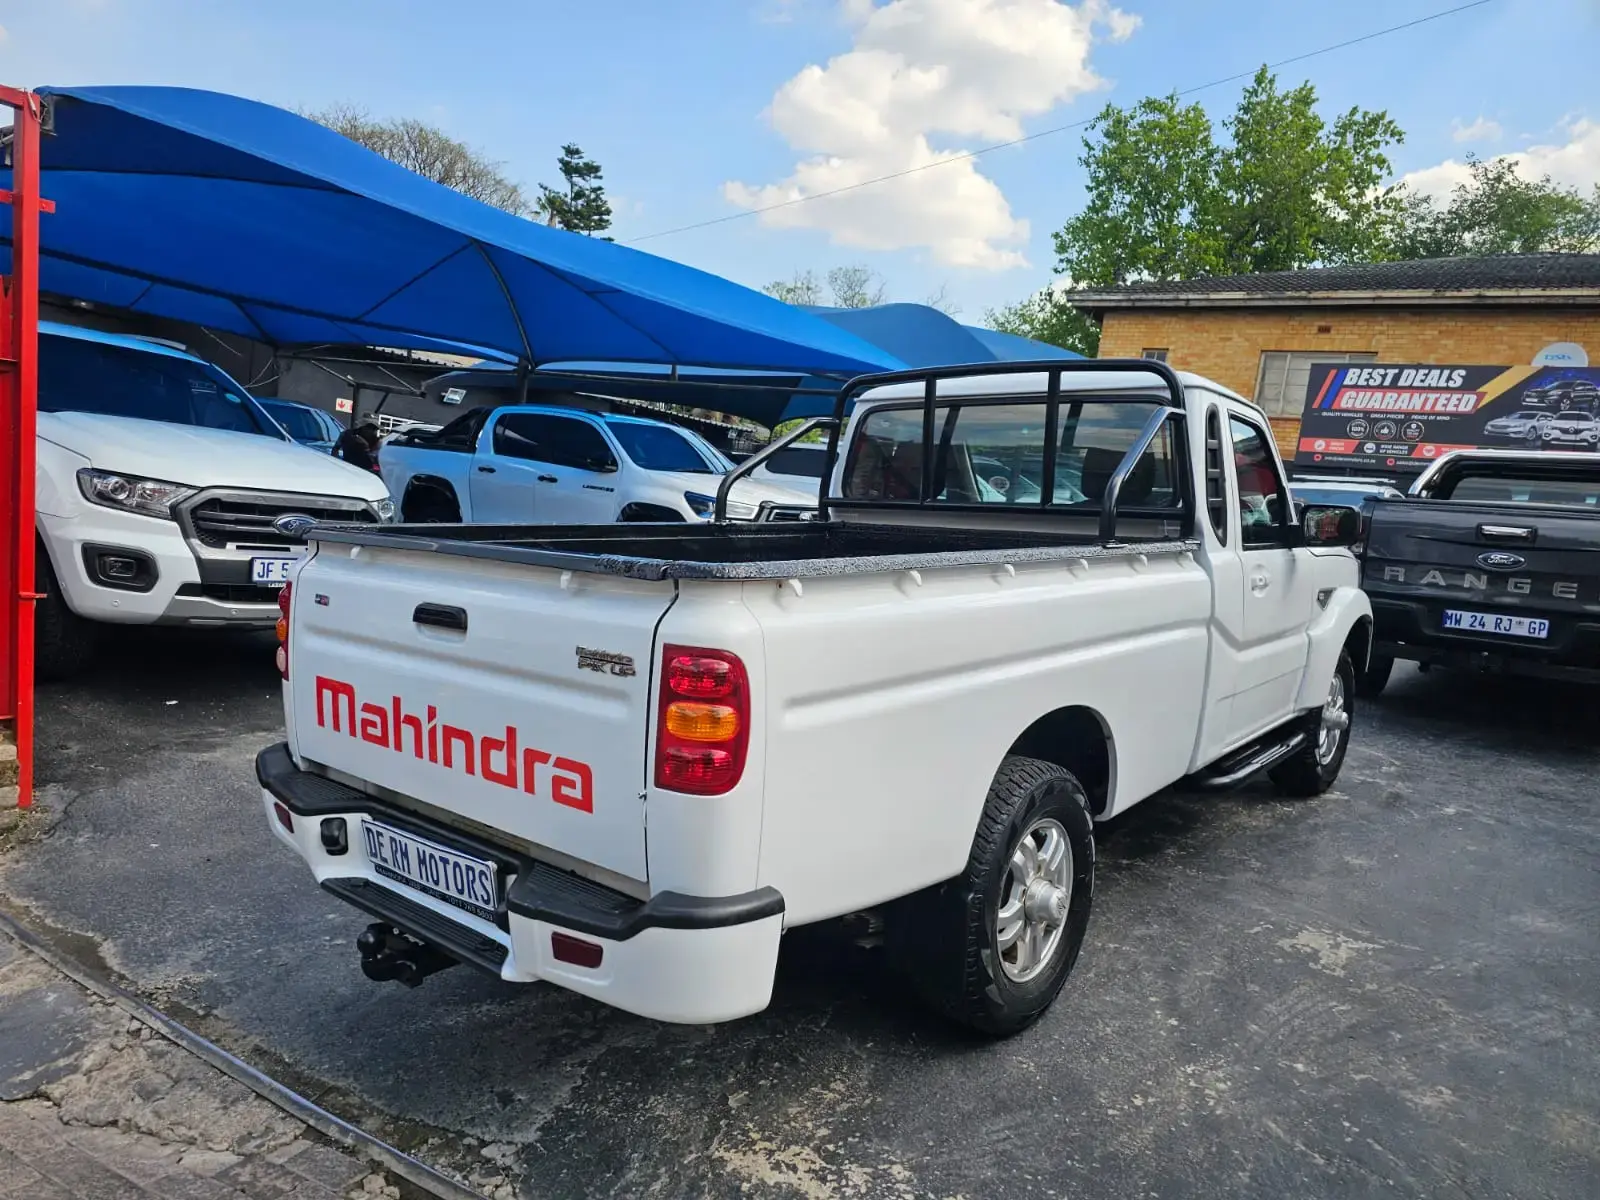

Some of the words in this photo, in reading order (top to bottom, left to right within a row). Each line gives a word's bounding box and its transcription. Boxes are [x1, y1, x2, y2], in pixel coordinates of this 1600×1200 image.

[1343, 368, 1399, 386] BEST
[1398, 369, 1467, 387] DEALS
[1340, 391, 1478, 412] GUARANTEED
[257, 562, 275, 579] JF
[1384, 566, 1600, 602] RANGE
[1444, 611, 1462, 627] MW
[1469, 613, 1486, 630] 24
[1494, 617, 1512, 632] RJ
[1528, 620, 1547, 636] GP
[365, 827, 388, 864] DE
[390, 836, 412, 875] RM
[417, 847, 492, 906] MOTORS
